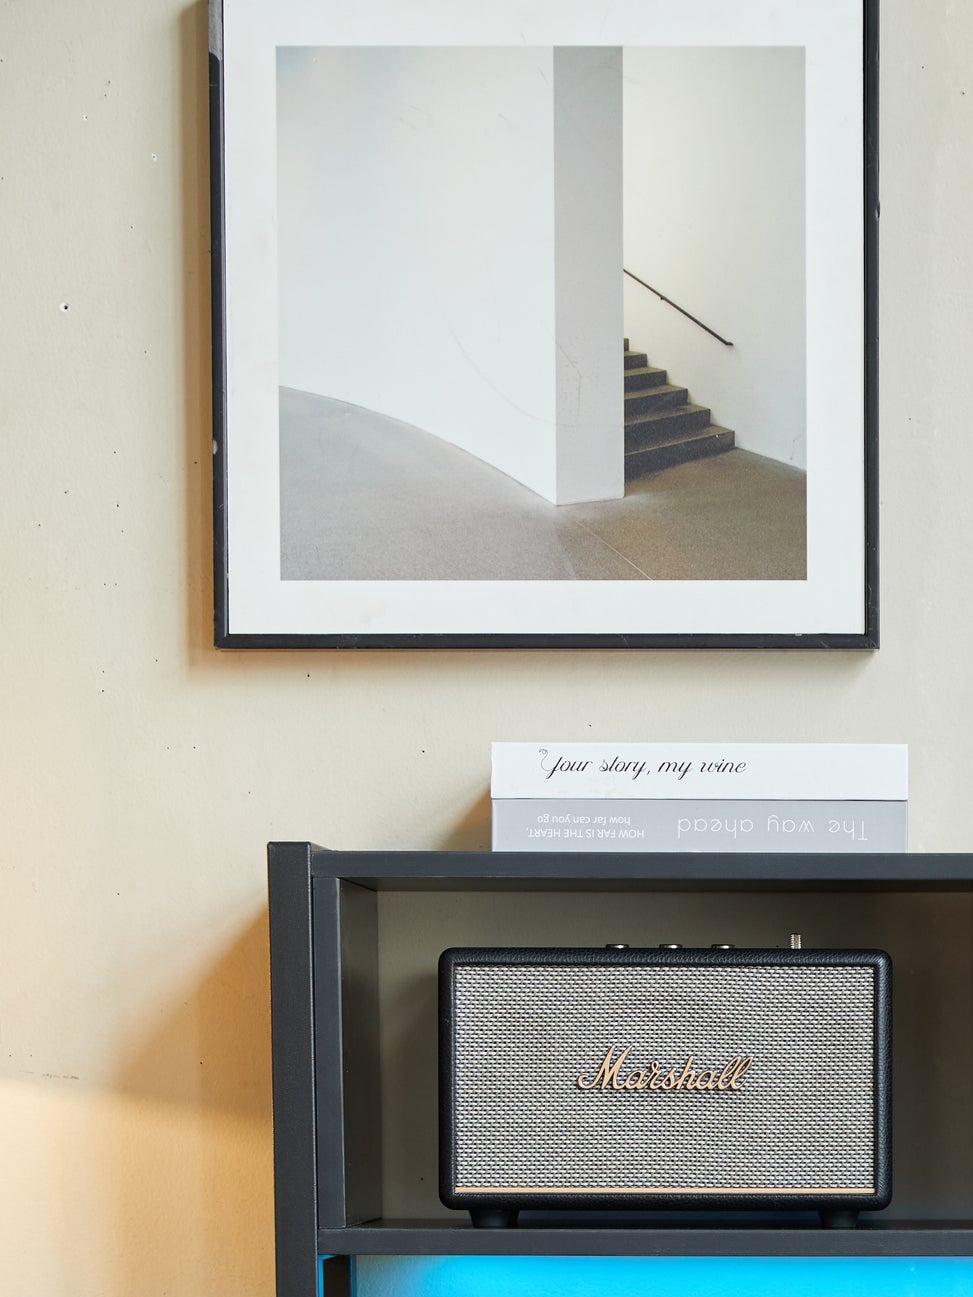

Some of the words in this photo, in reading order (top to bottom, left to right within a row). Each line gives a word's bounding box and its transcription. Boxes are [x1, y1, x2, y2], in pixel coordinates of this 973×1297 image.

[539, 749, 593, 779] Your
[600, 757, 650, 779] story,
[658, 762, 691, 780] my
[701, 759, 746, 773] wine
[537, 814, 549, 824] go
[552, 814, 571, 824] you
[573, 816, 591, 824] can
[593, 816, 607, 826] far
[610, 816, 631, 826] how
[768, 815, 814, 832] way
[526, 826, 562, 838] HEART,
[565, 828, 584, 838] THE
[586, 828, 594, 838] IS
[597, 828, 616, 838] FAR
[619, 828, 644, 838] HOW
[678, 818, 753, 839] ahead
[828, 816, 868, 840] The
[578, 1044, 754, 1090] Marshall
